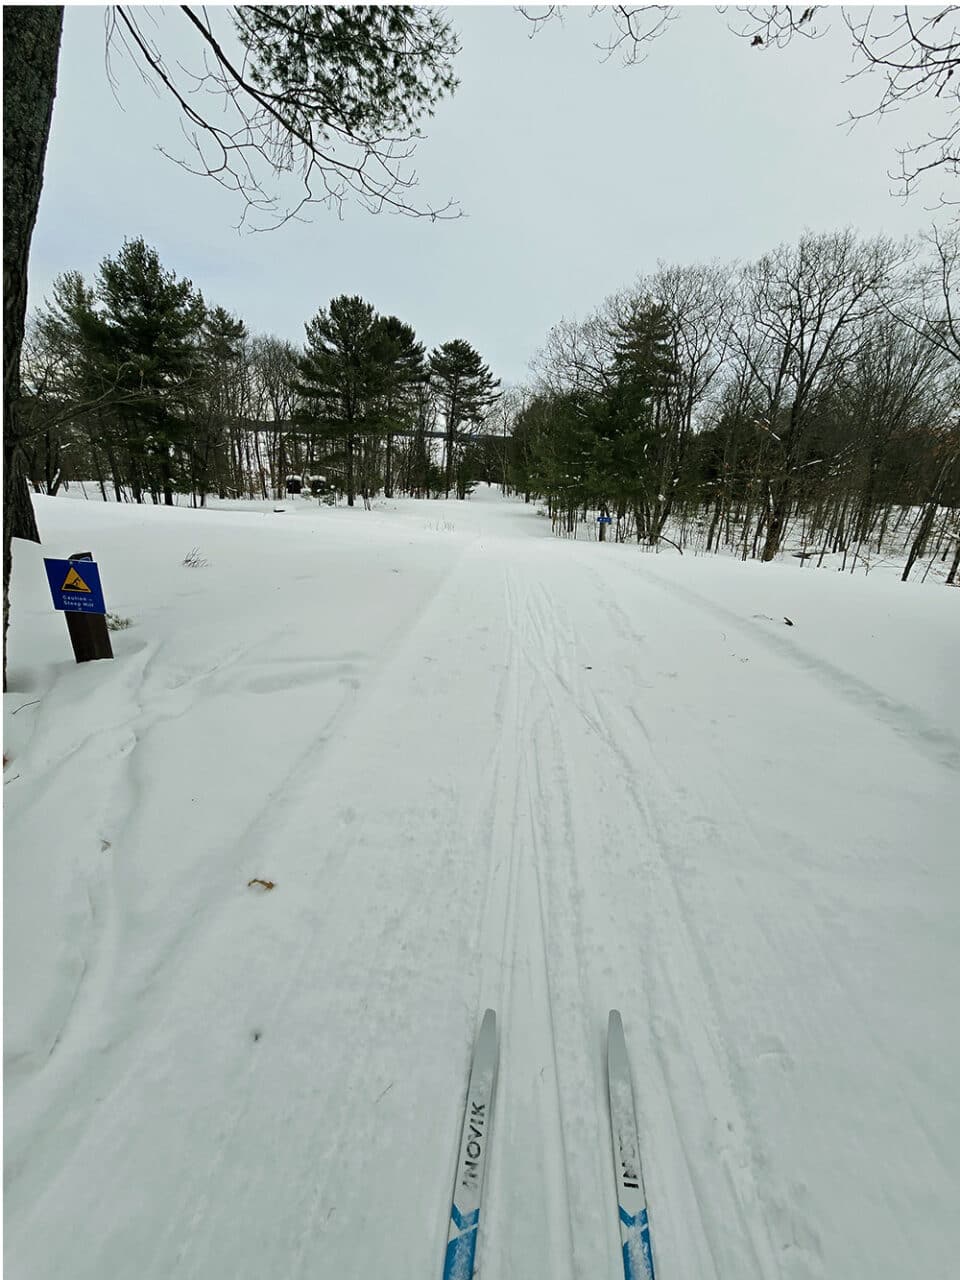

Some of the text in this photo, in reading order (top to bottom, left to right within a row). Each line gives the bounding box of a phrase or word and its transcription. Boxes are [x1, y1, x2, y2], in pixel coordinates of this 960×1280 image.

[62, 594, 87, 602] Caution
[63, 600, 82, 608] Steep
[462, 1101, 486, 1191] INOVIK
